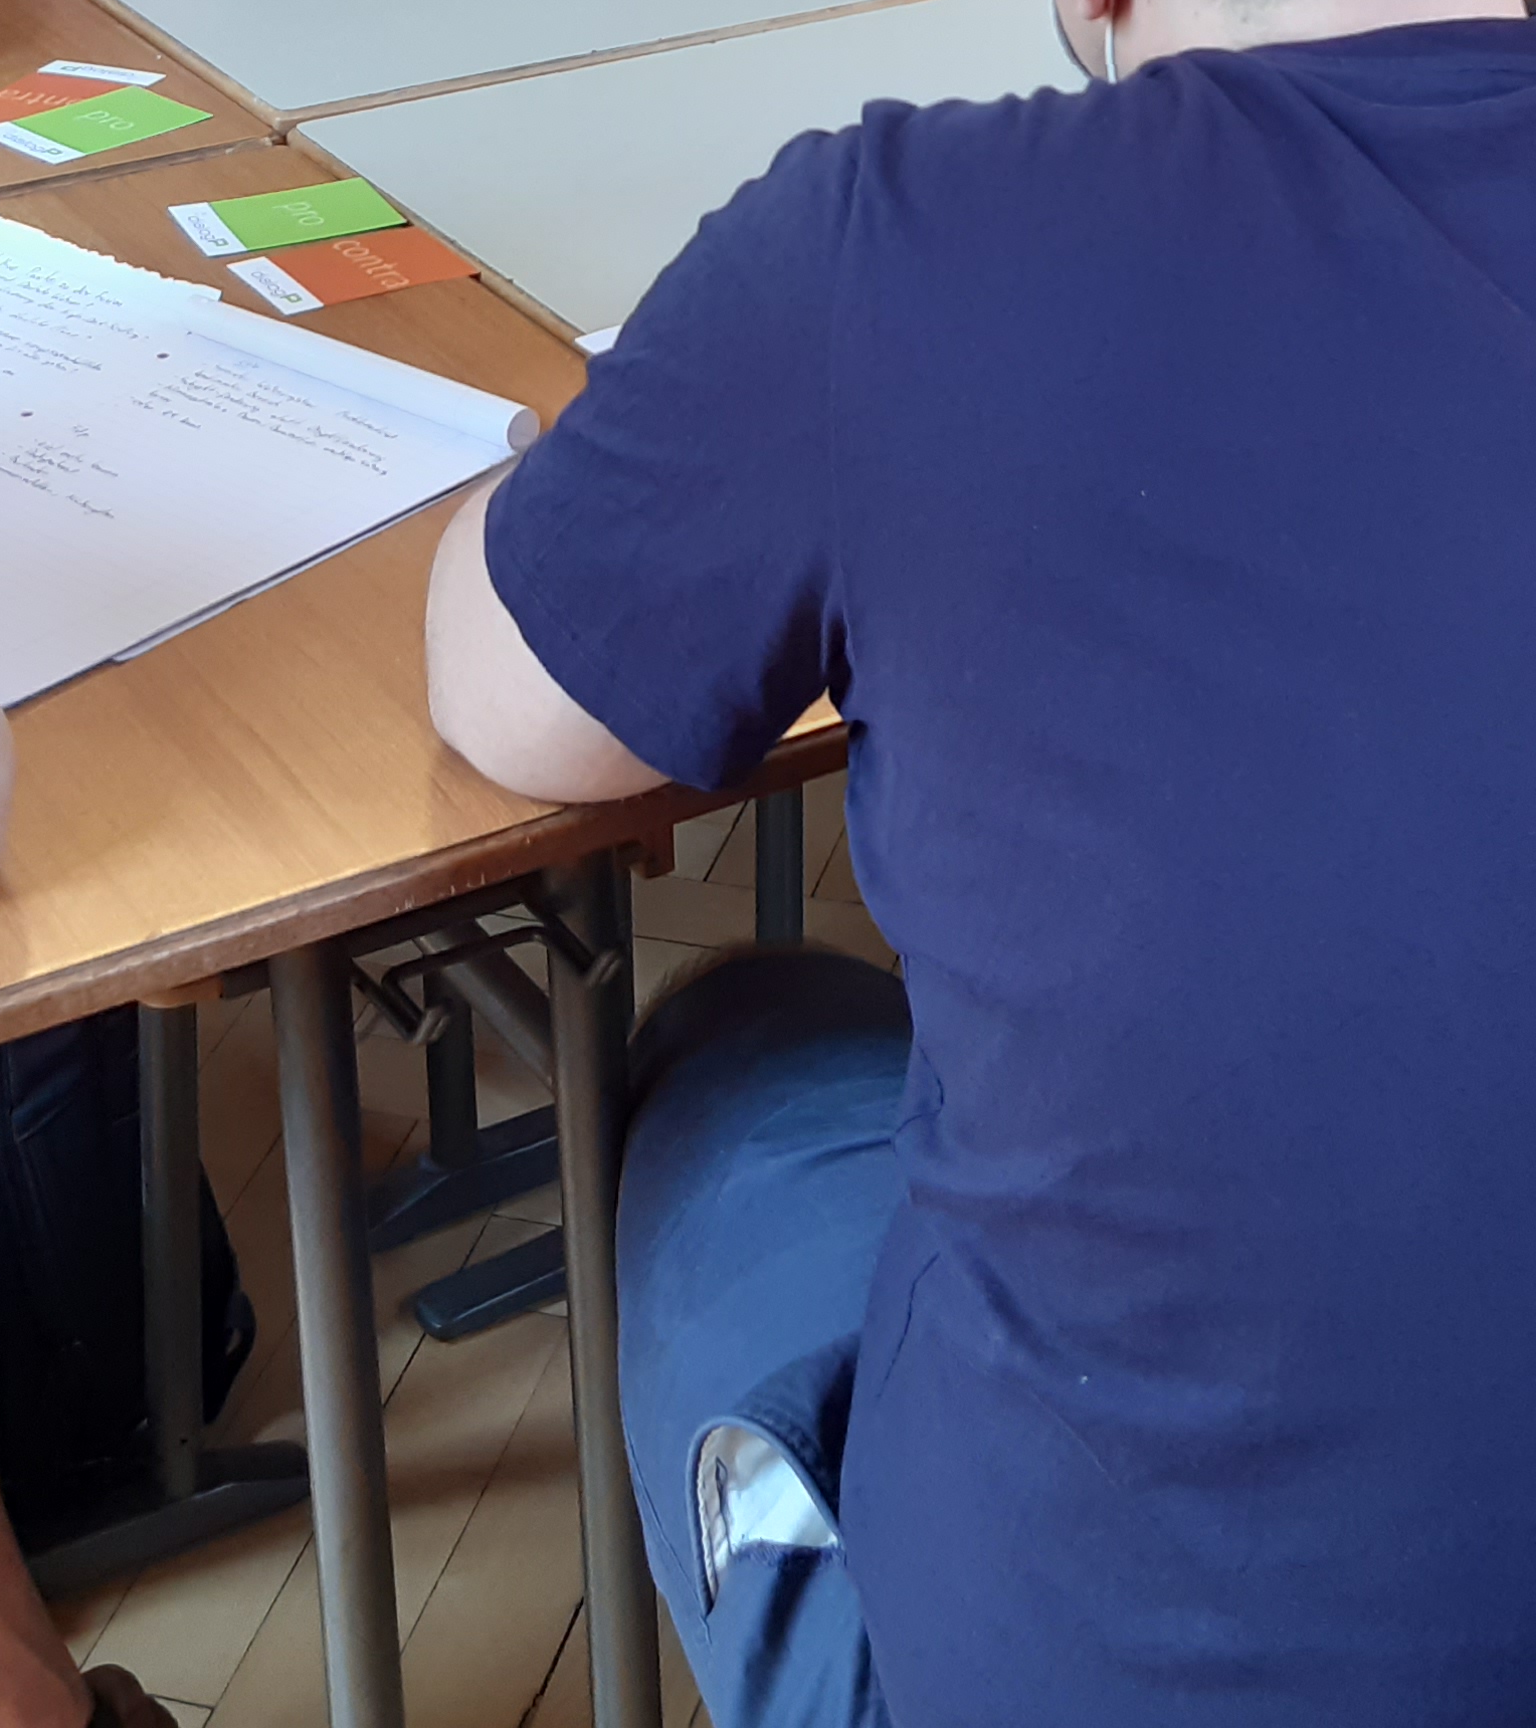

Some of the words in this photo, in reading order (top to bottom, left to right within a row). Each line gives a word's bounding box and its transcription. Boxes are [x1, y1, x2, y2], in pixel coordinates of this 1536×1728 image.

[75, 109, 135, 131] pro
[272, 200, 325, 227] pro
[332, 238, 411, 290] contra
